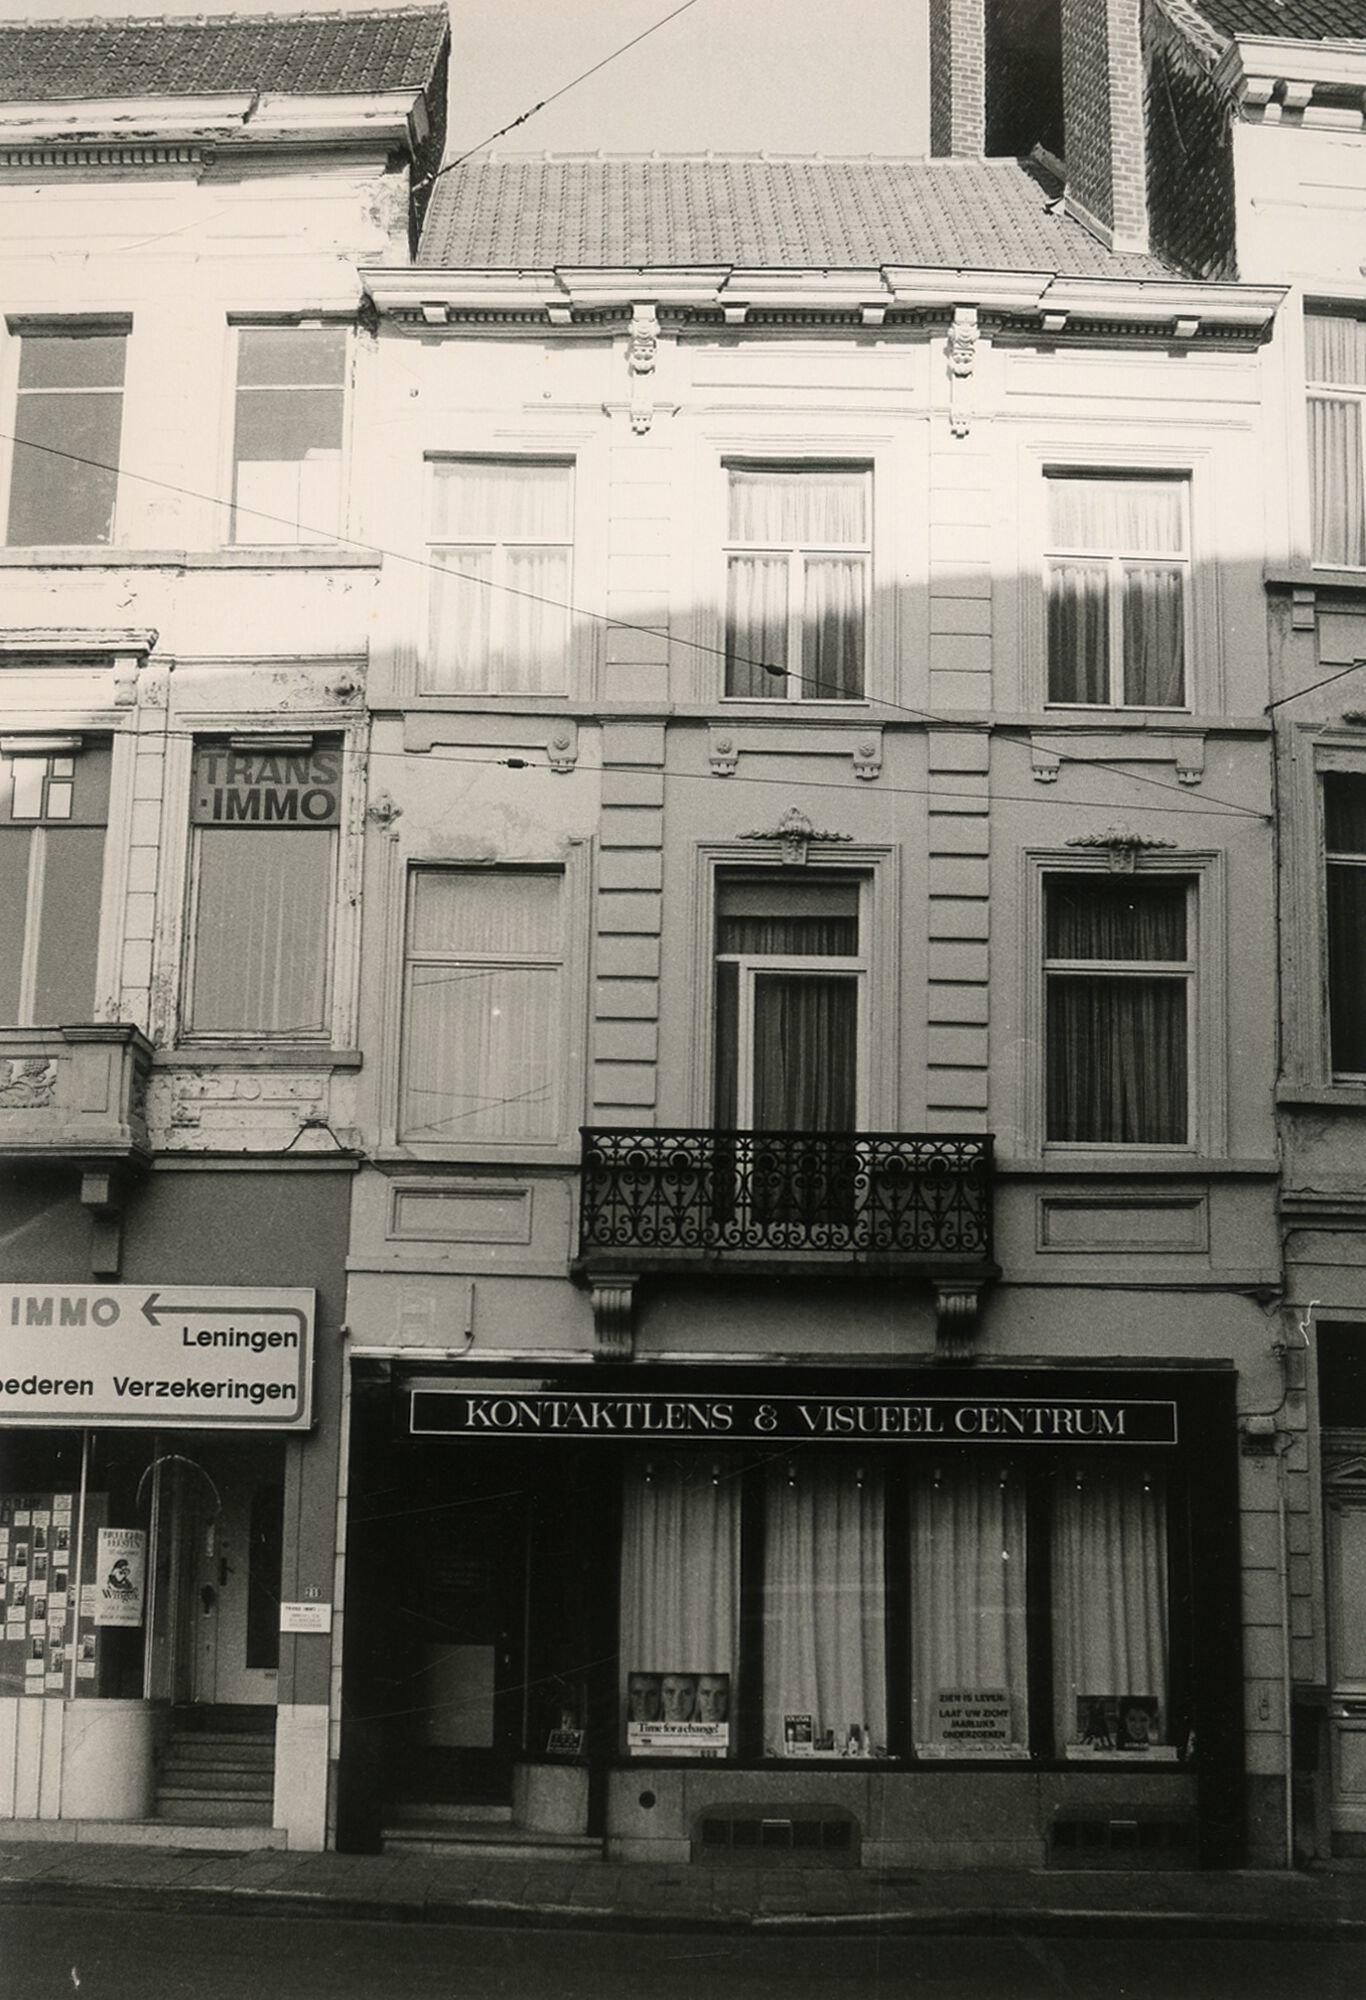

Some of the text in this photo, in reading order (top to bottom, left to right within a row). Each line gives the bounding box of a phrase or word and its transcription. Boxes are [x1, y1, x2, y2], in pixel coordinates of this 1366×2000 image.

[200, 752, 339, 785] TRANS
[11, 1296, 121, 1328] IMMO
[183, 1326, 298, 1353] Leningen
[0, 1374, 297, 1405] ederen Verzekeringen
[464, 1399, 1127, 1436] KONTAKTLENS & VISUEEL CENTRUM
[638, 1723, 662, 1732] Time
[664, 1723, 676, 1732] for
[939, 1710, 962, 1718] LAAT
[983, 1710, 1009, 1718] ZICHT
[943, 1731, 1006, 1739] ONDERZOEKEN
